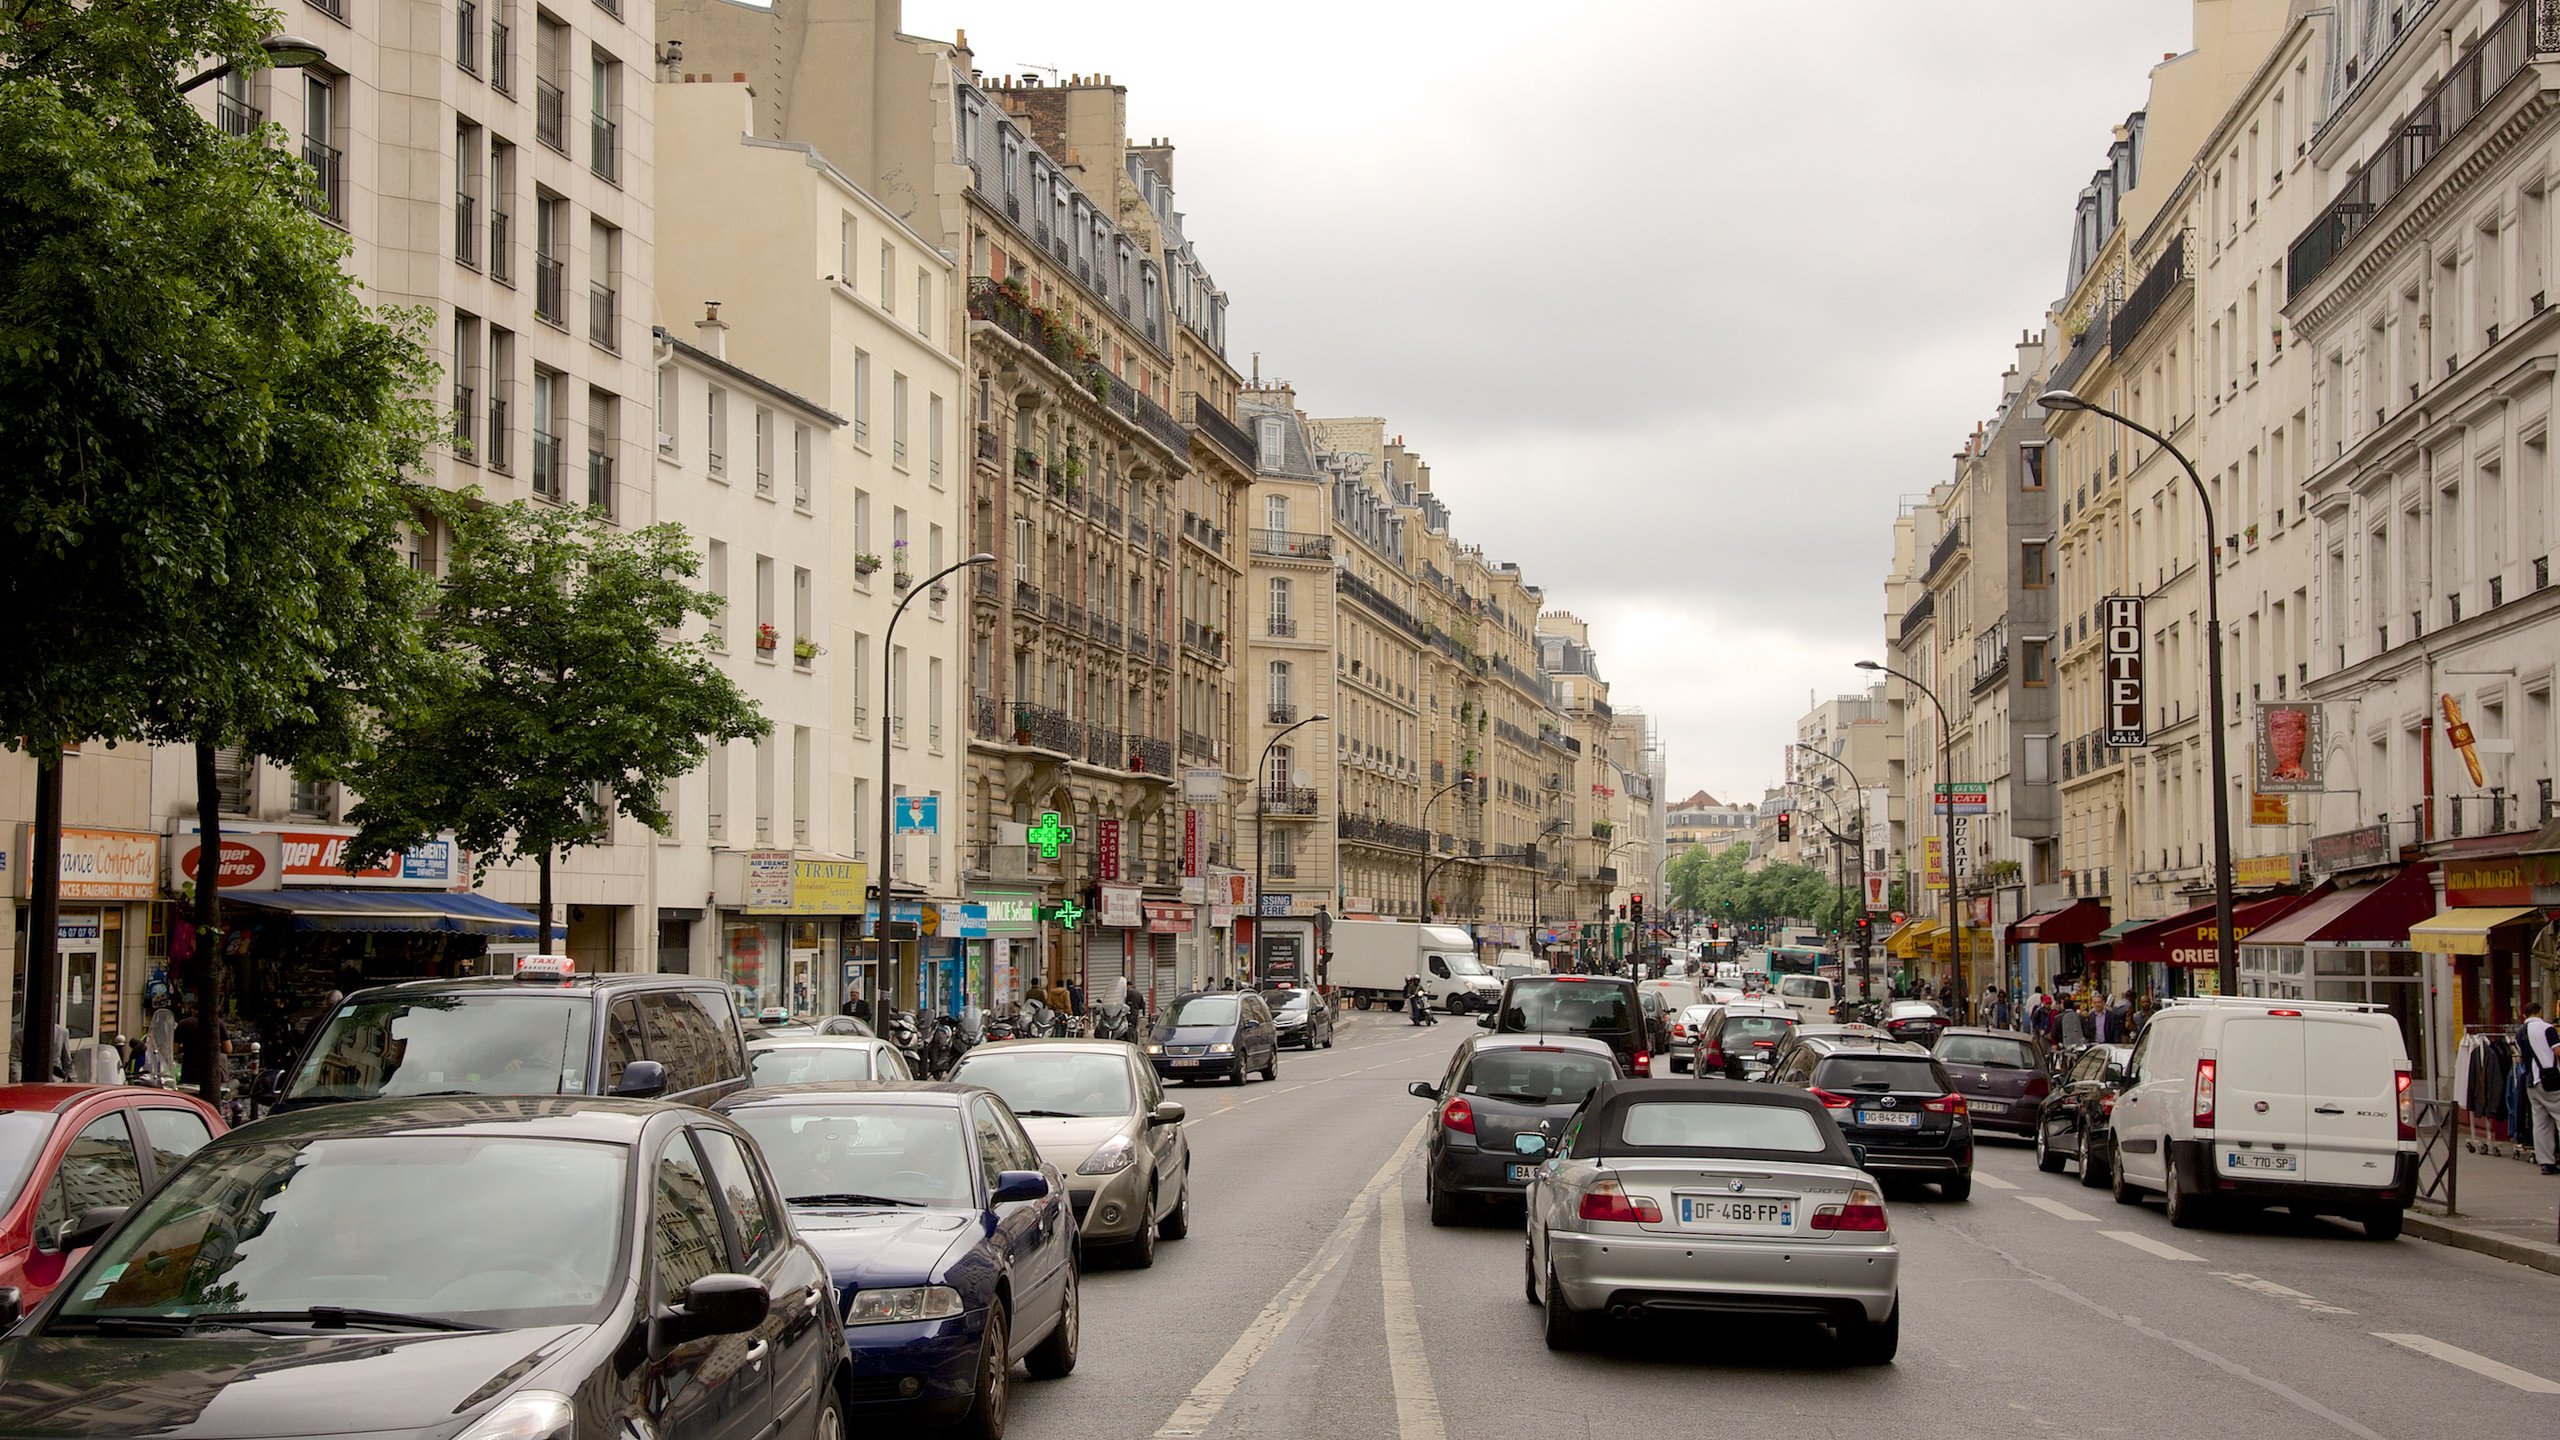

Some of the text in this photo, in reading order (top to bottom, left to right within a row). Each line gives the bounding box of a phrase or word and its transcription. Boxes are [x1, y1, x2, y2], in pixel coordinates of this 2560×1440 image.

[2110, 600, 2140, 731] HOTEL
[2257, 707, 2268, 782] RESTAURANT
[2311, 705, 2323, 782] ISTANBUL
[406, 843, 447, 860] ETEMENTS
[1187, 810, 1195, 878] BOULANGERIE
[1955, 817, 1968, 877] DUCATI
[282, 841, 319, 871] per
[1109, 832, 1117, 877] MAGHREB
[804, 863, 852, 879] TRAVEL
[2255, 856, 2290, 873] ORIENTALE
[81, 884, 117, 897] PAIEMENT
[119, 885, 134, 898] PAR
[135, 886, 153, 898] MOIS
[1261, 895, 1290, 906] SSING
[1248, 906, 1287, 916] LVERIE
[68, 928, 77, 938] 07
[78, 928, 86, 938] 07
[87, 928, 97, 938] 95
[2171, 948, 2219, 963] ORIE
[2236, 1155, 2289, 1169] AL-770-SP
[1696, 1203, 1778, 1222] DF-468-FP
[1783, 1212, 1792, 1223] 91
